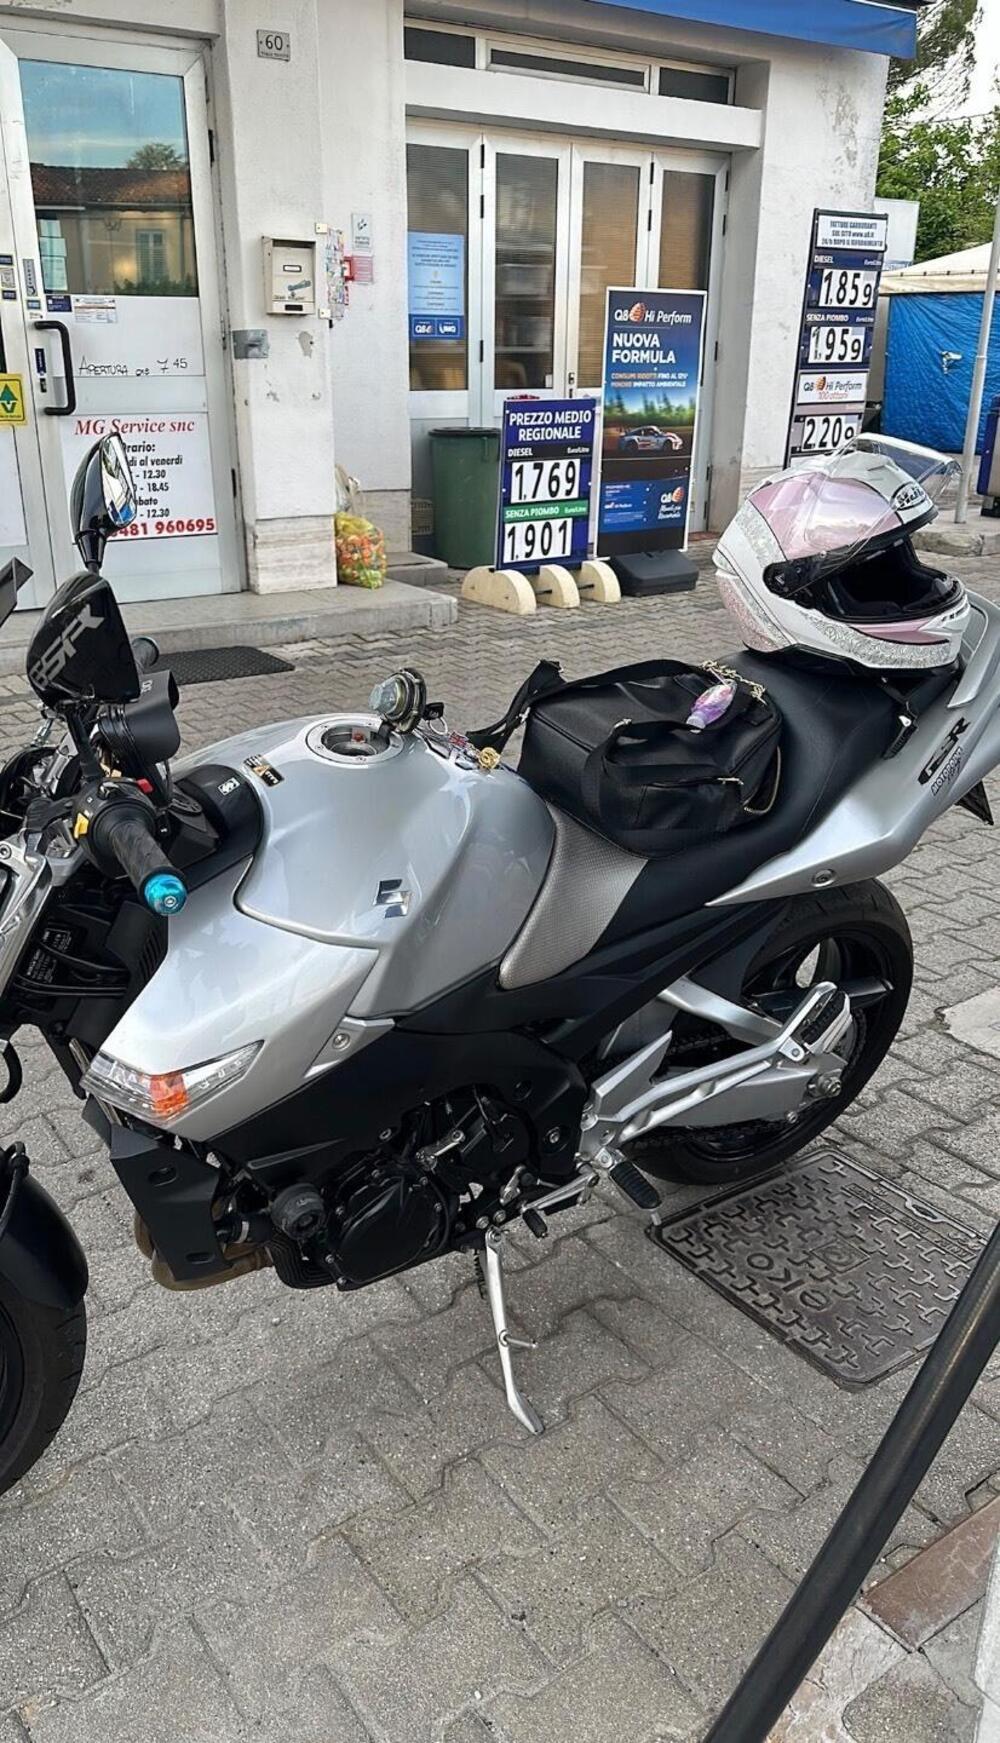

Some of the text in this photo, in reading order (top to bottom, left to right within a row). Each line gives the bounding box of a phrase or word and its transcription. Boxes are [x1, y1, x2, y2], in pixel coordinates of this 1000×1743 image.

[265, 34, 283, 51] 60
[814, 255, 833, 263] DIESEL
[614, 309, 692, 326] Q8 Hi Perform
[806, 313, 825, 322] SENZA
[826, 314, 849, 322] PIOMBO
[613, 333, 660, 347] NUOVA
[611, 350, 676, 363] FORMULA
[172, 358, 188, 369] 45
[803, 382, 814, 392] Q8
[834, 380, 862, 392] Perform
[509, 410, 592, 426] PREZZO MEDIO
[75, 418, 195, 435] MG Service snc
[518, 426, 581, 441] REGIONALE
[507, 447, 533, 457] DIESEL
[139, 456, 148, 466] al
[143, 469, 166, 479] 12.30
[147, 482, 169, 492] 18.45
[147, 508, 170, 518] 12.30
[505, 508, 529, 519] SENZA
[530, 505, 560, 517] PIOMBO
[110, 518, 215, 537] 481 960695
[918, 717, 971, 785] GSR
